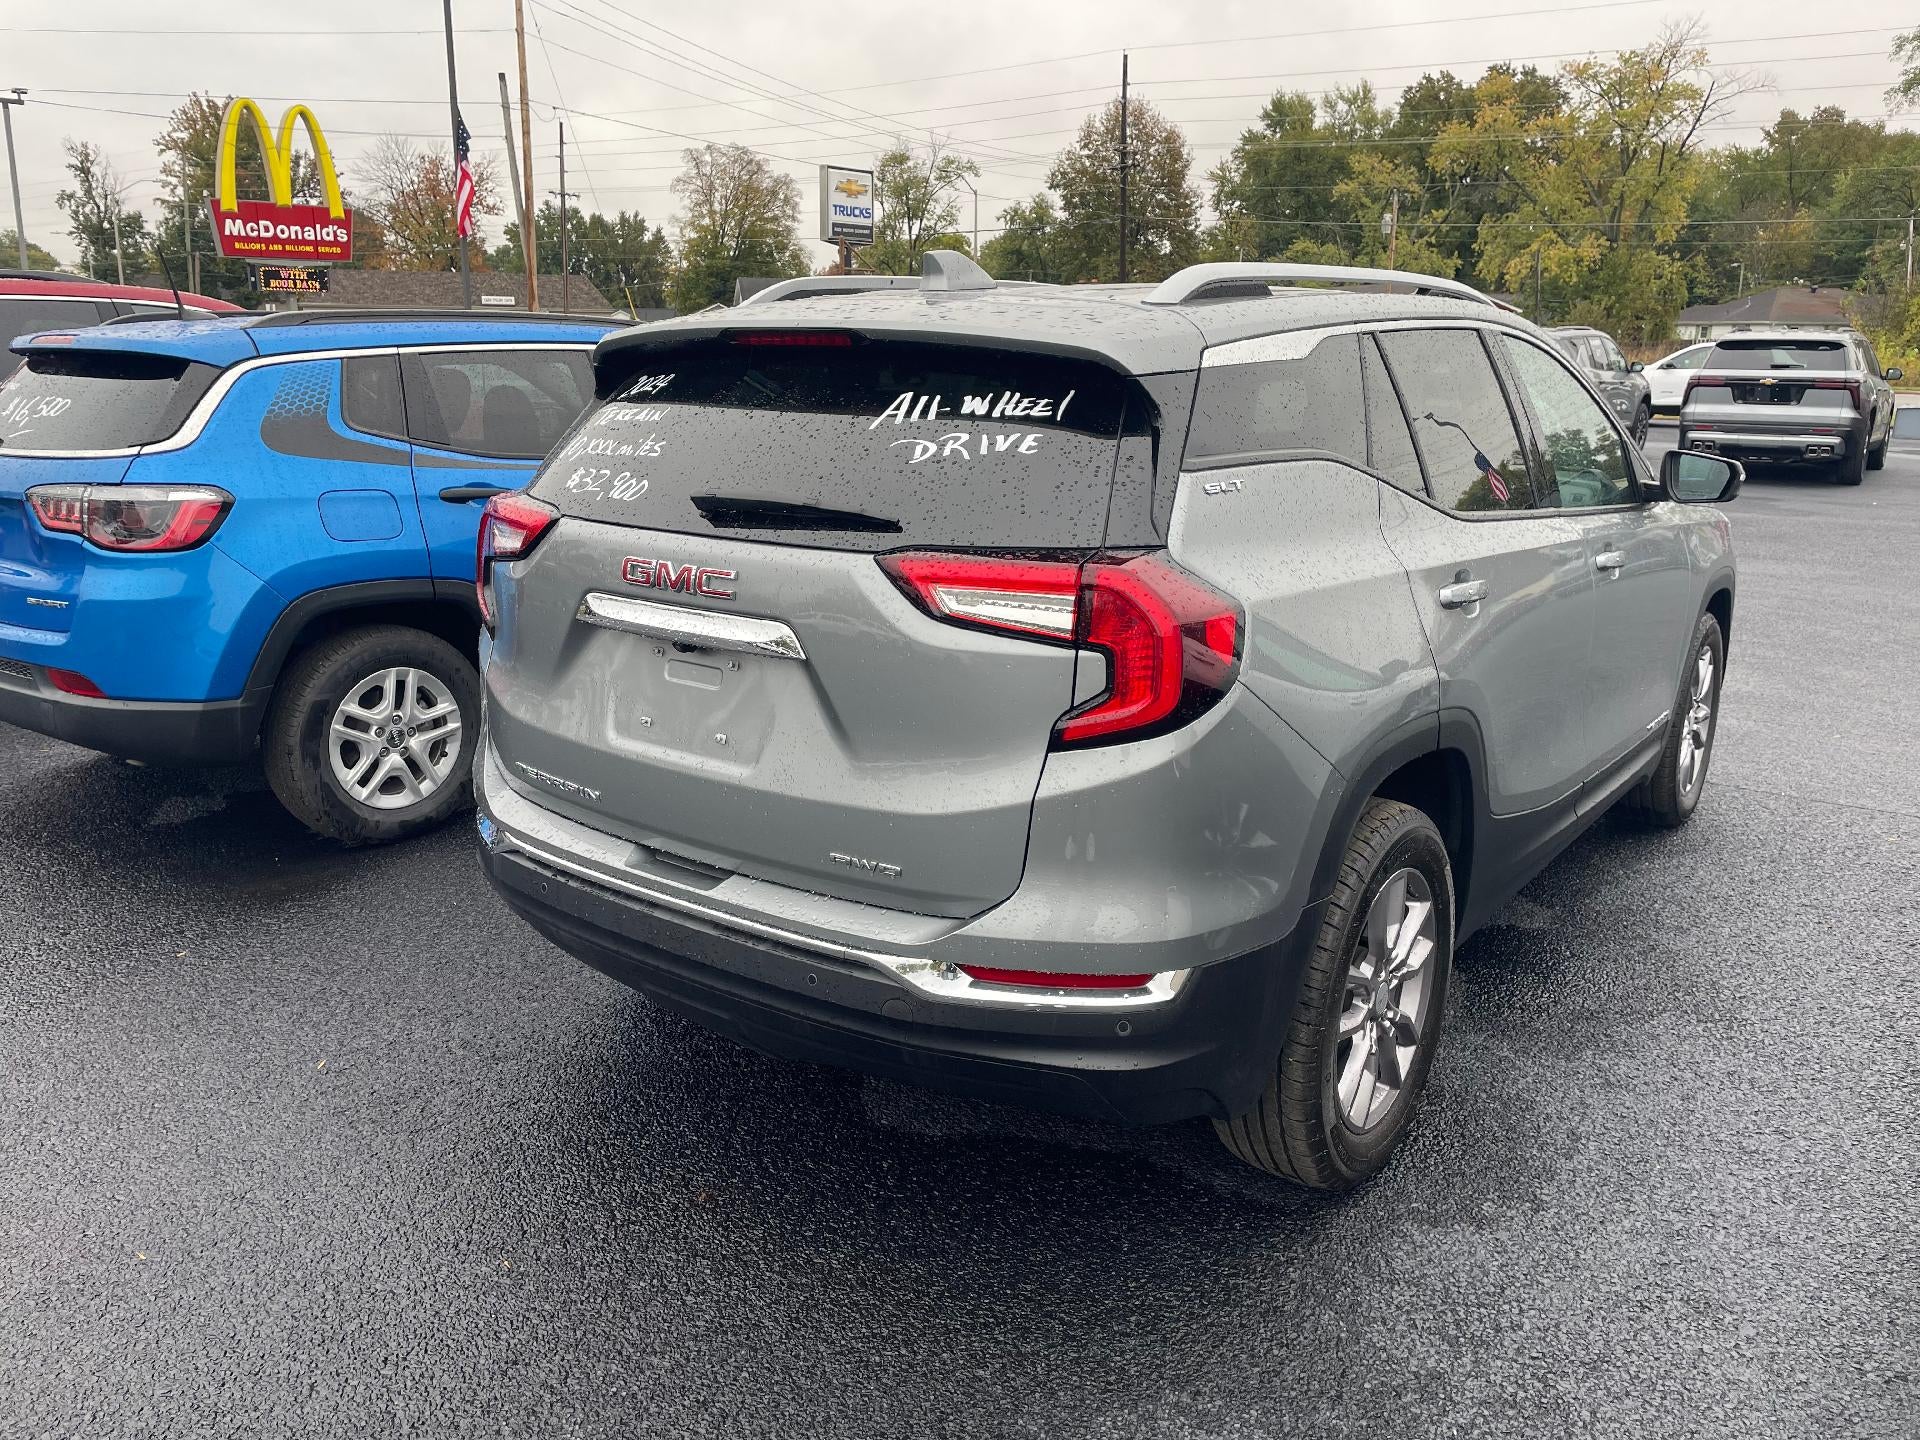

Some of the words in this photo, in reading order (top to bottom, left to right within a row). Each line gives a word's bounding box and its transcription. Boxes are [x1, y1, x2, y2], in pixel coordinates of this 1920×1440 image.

[832, 204, 872, 219] TRUCKS
[224, 218, 348, 243] McDonald's
[234, 242, 267, 251] BILLIONS
[269, 243, 283, 251] AND
[285, 244, 314, 253] BILLIONS
[317, 246, 342, 254] SERVED
[269, 279, 294, 288] DOOR
[280, 270, 308, 280] WITH
[1, 395, 72, 428] $16,500
[889, 432, 1044, 464] DRIVE
[566, 466, 649, 501] $32,900
[1203, 479, 1246, 497] SLT
[622, 555, 738, 601] GMC
[514, 761, 602, 802] TERRAIN
